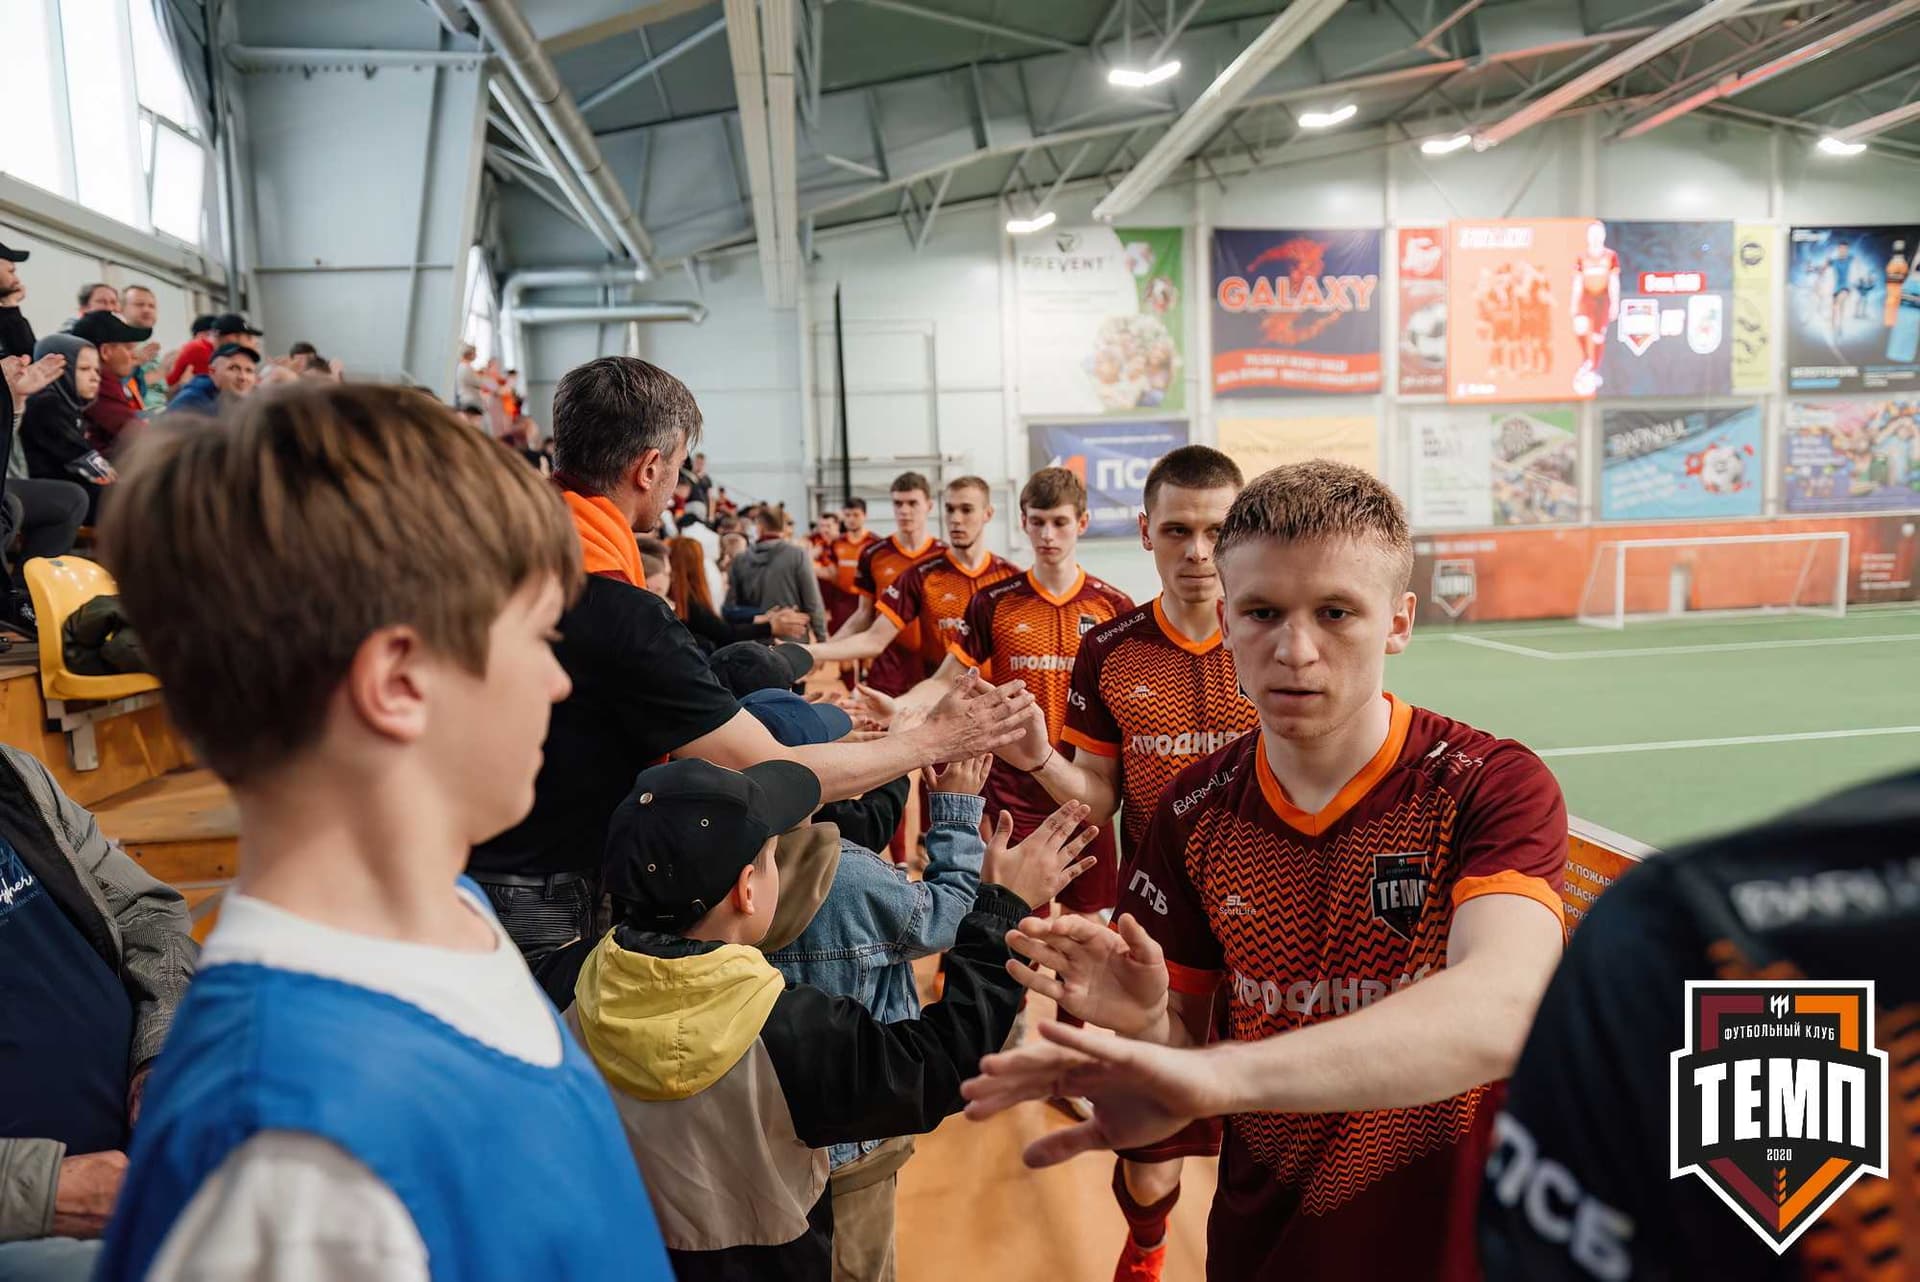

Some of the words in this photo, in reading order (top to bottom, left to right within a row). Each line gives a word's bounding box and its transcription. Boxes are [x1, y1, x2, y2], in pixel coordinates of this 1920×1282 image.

[1021, 255, 1104, 272] PREVENT
[1217, 275, 1378, 312] GALAXY
[1484, 1110, 1636, 1282] ПСБ
